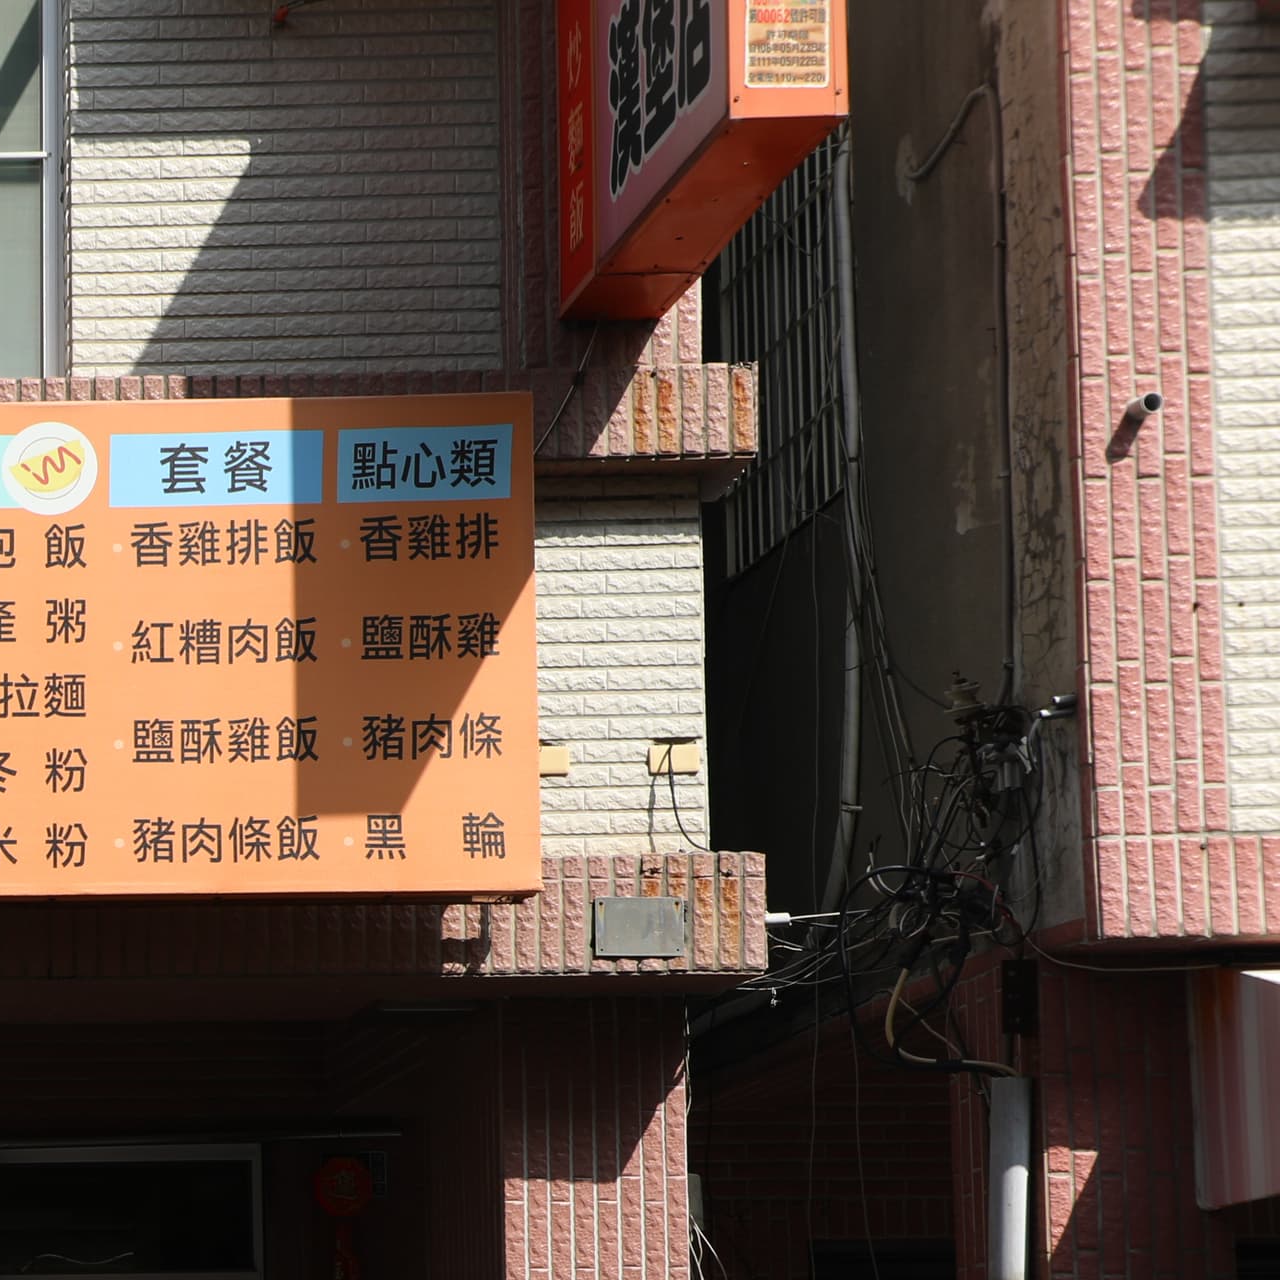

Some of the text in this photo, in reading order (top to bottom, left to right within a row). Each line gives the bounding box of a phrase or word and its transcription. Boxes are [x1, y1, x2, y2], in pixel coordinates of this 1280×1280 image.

[158, 440, 274, 496] 套餐
[350, 437, 499, 492] 點心類
[129, 517, 319, 569] 香雞排飯
[358, 511, 500, 562] 香雞排
[130, 615, 319, 667] 紅糟肉飯
[360, 611, 501, 662] 鹽酥雞
[132, 715, 321, 766] 鹽酥雞飯
[362, 711, 503, 762] 豬肉條
[133, 812, 321, 865] 豬肉條飯
[364, 811, 507, 862] 黑輪
